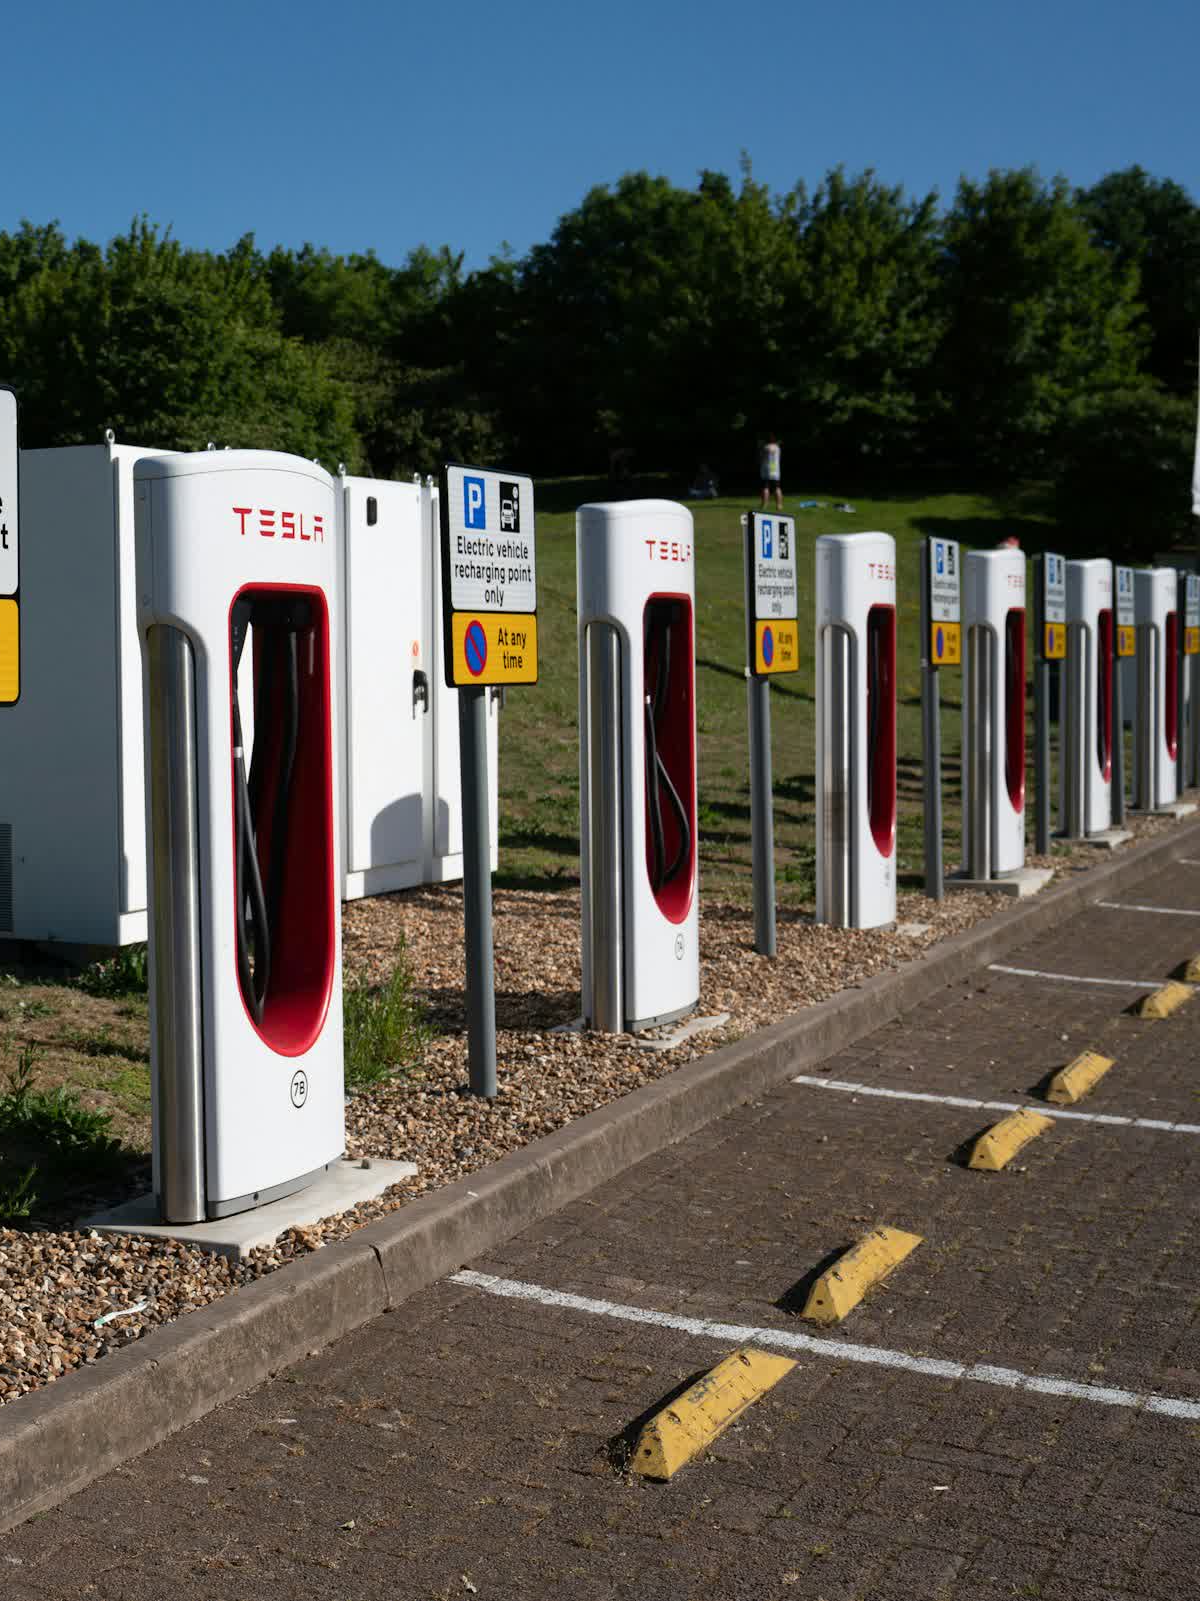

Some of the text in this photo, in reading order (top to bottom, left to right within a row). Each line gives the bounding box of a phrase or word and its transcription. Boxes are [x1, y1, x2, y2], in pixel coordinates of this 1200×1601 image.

[467, 483, 482, 525] P
[232, 507, 323, 543] TESLA
[457, 535, 529, 560] Electric vehicle
[455, 560, 532, 585] recharging point
[484, 585, 504, 607] only
[497, 628, 526, 650] At any
[503, 650, 522, 669] time
[294, 1081, 305, 1097] 7B
